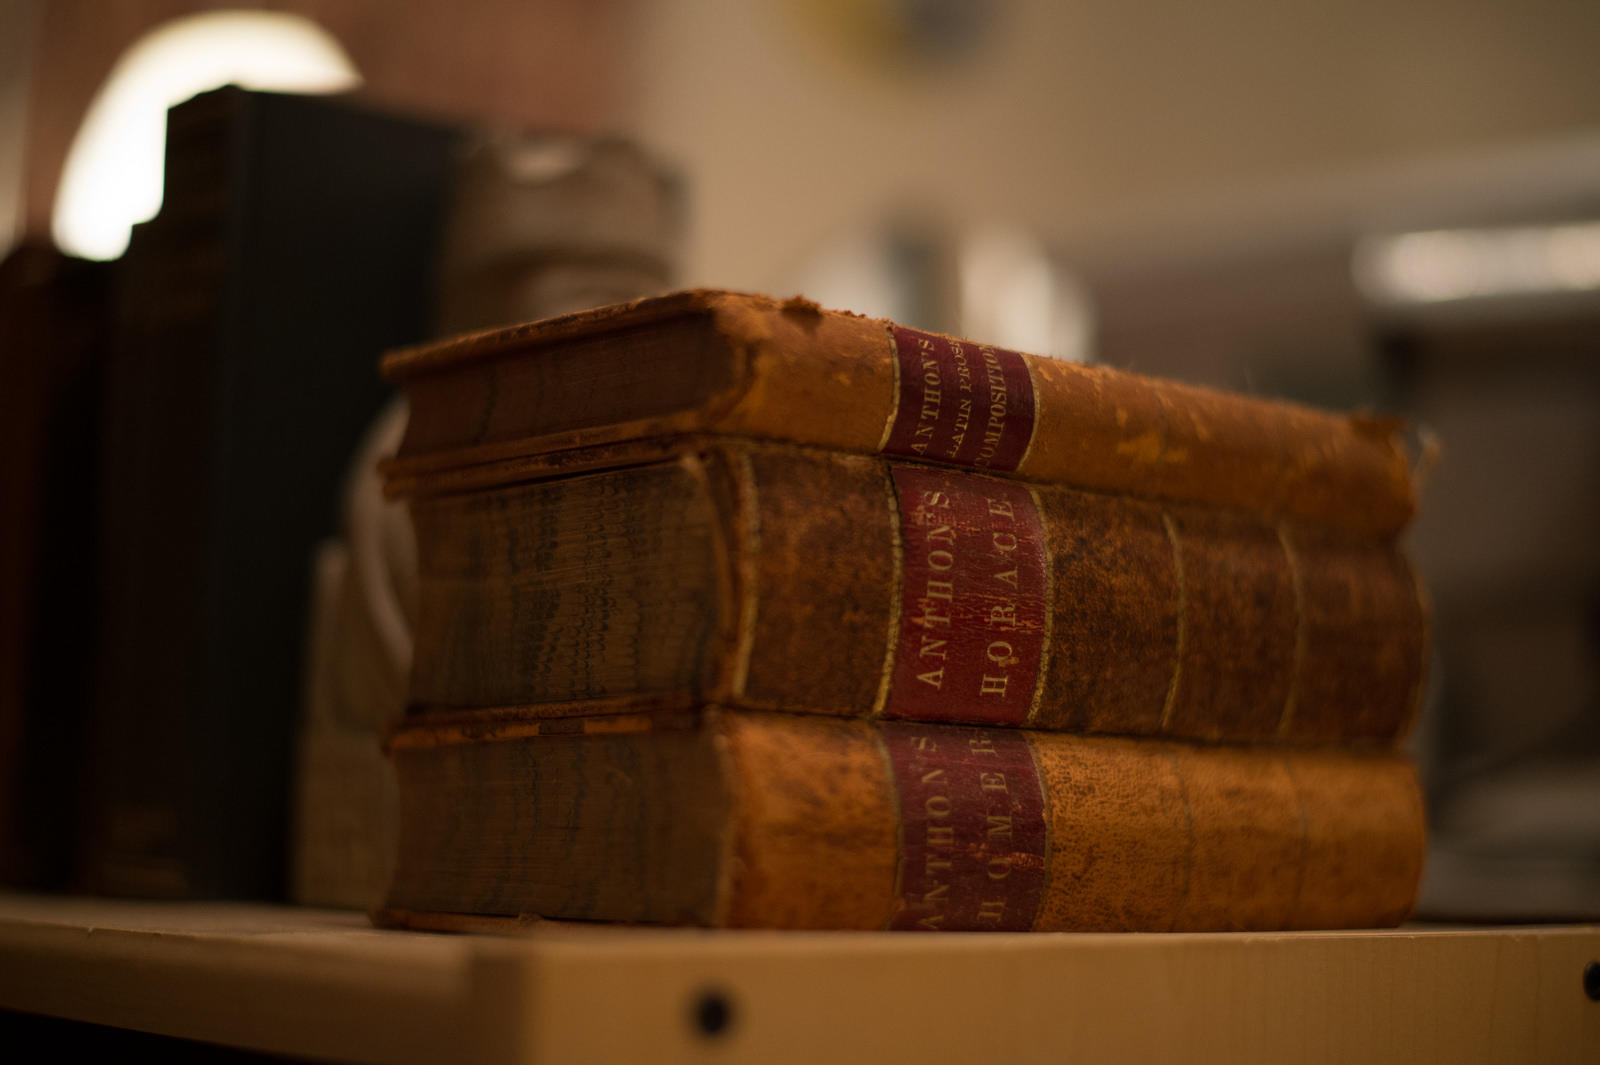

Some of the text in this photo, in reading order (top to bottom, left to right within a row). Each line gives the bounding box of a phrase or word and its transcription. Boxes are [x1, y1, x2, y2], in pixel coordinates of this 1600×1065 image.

[910, 338, 941, 455] ANTHON'S
[945, 399, 972, 458] LATIN
[979, 497, 1018, 697] HORACE
